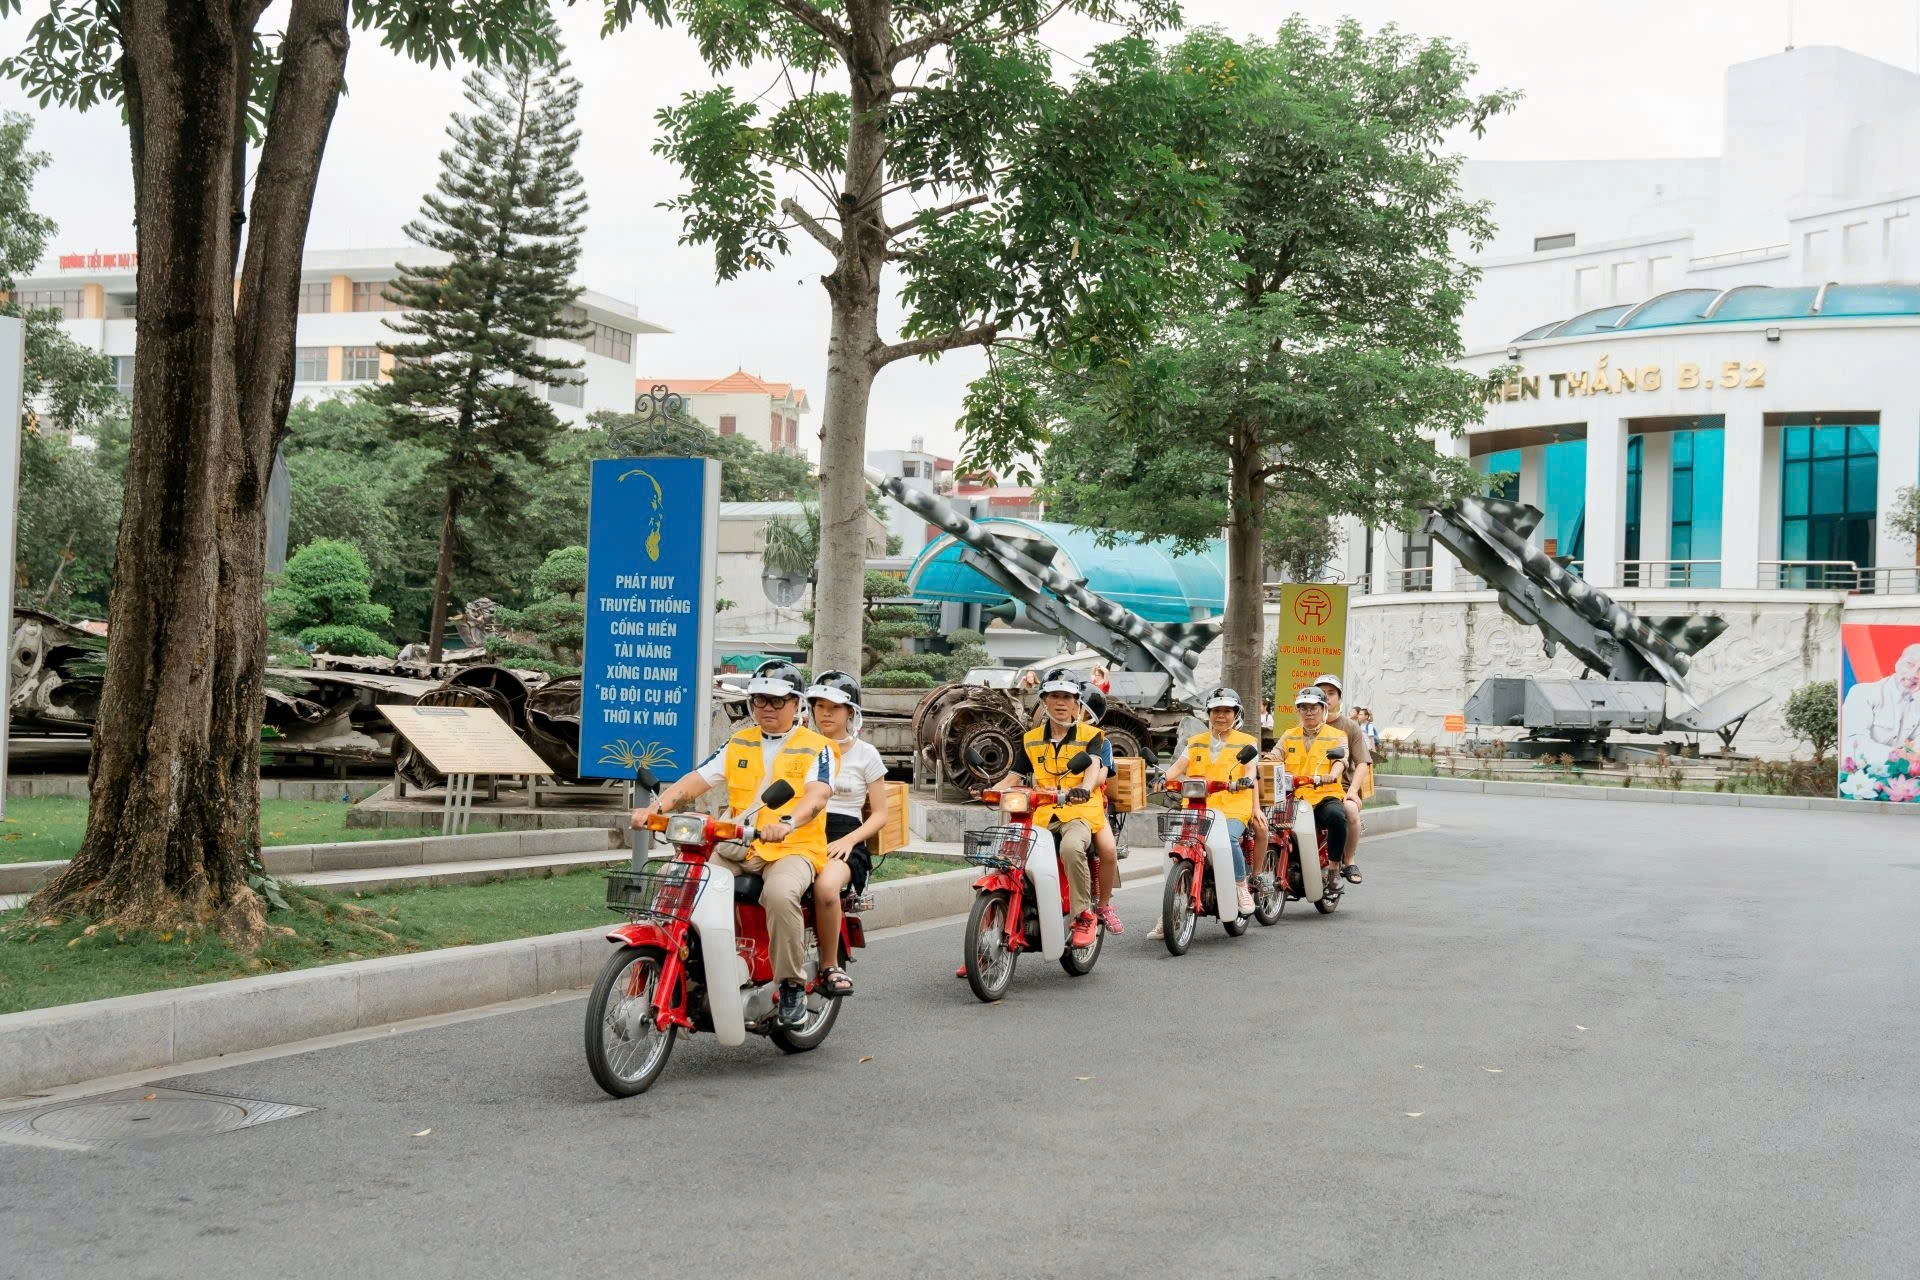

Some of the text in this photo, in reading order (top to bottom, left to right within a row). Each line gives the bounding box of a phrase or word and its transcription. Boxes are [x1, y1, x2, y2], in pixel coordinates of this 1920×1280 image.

[1549, 351, 1662, 398] THẮNG
[1677, 360, 1767, 390] B.52
[616, 573, 675, 590] PHÁT HUY
[600, 594, 691, 613] TRUYỀN THỐNG
[610, 617, 677, 637] CỐNG HIẾN
[614, 641, 672, 659] TÀI NĂNG
[606, 662, 678, 681] XỨNG DANH
[595, 684, 617, 704] "BỘ
[620, 685, 641, 705] ĐỘI
[644, 688, 661, 706] CỤ
[603, 706, 678, 727] THỜI KỲ MỚI
